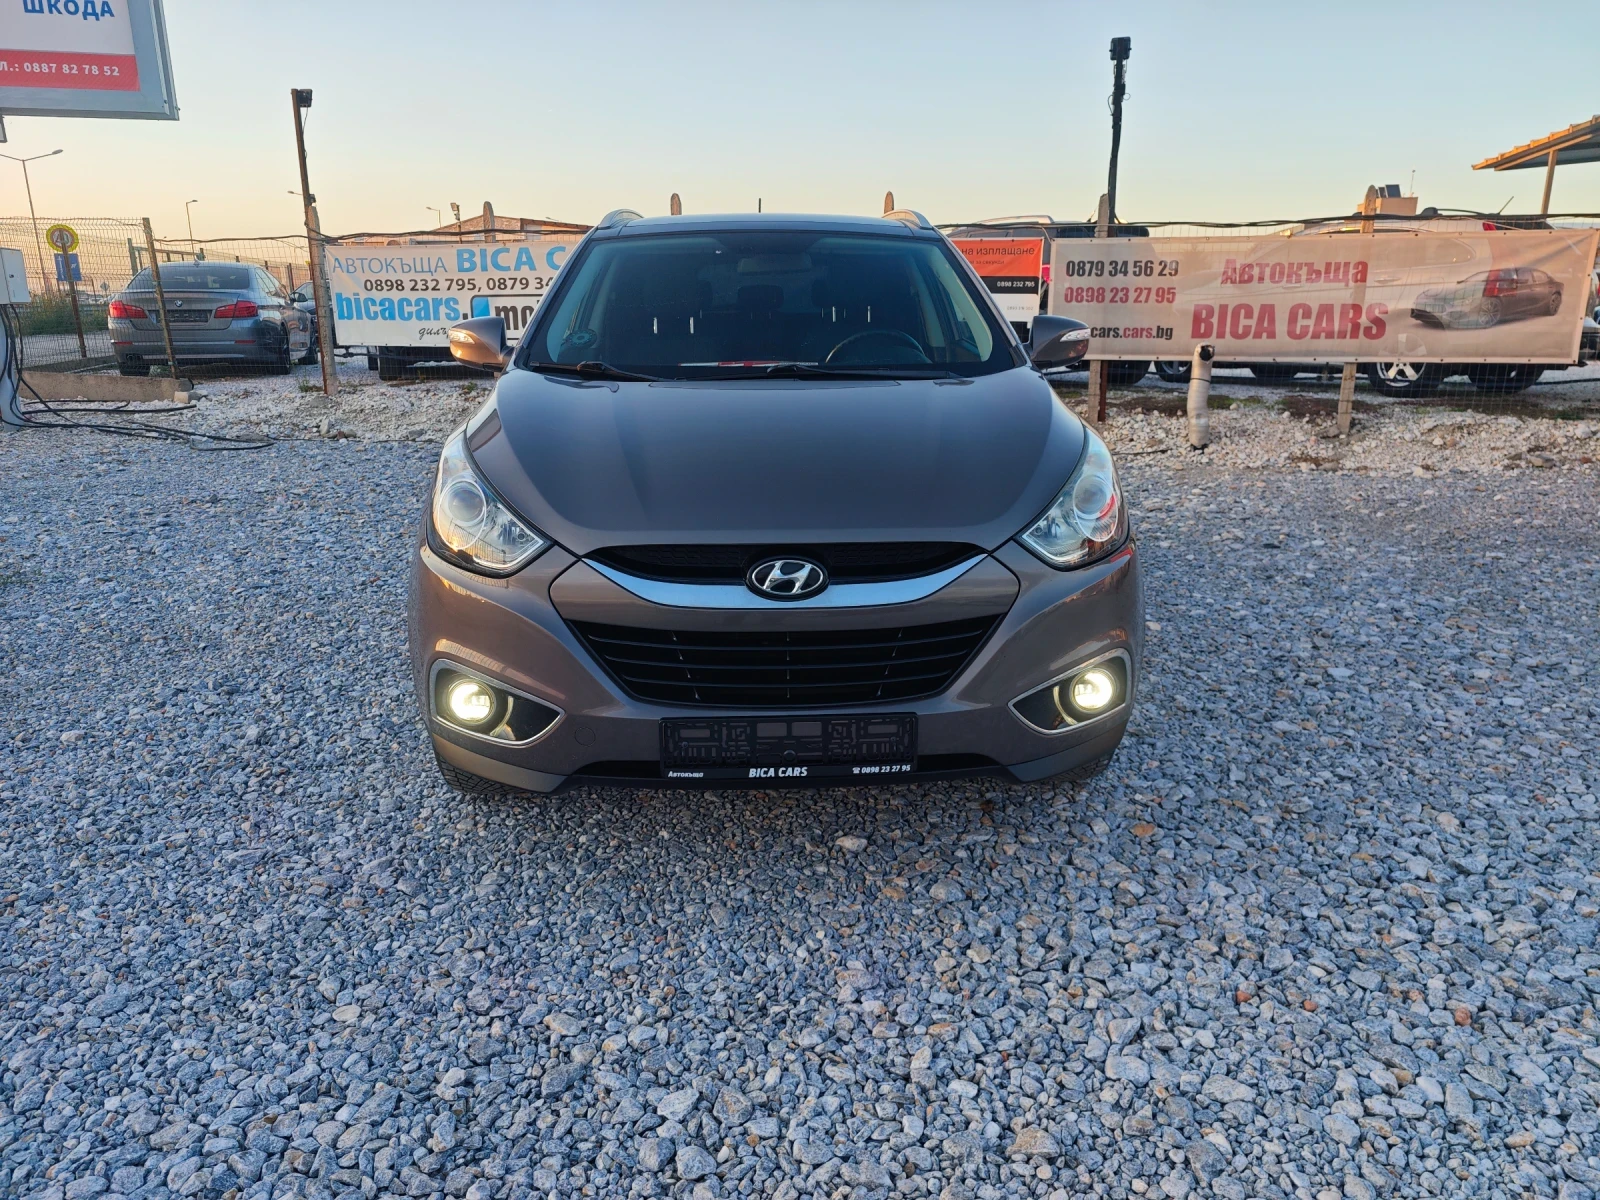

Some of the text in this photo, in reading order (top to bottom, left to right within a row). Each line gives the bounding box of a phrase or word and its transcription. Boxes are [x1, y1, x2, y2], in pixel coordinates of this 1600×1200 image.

[22, 0, 115, 21] ШКОДА
[24, 62, 57, 74] 0887
[62, 64, 79, 75] 82
[82, 65, 100, 75] 78
[103, 66, 120, 76] 52
[976, 247, 1035, 256] изплащане
[332, 256, 448, 277] АВТОКЪЩА
[456, 247, 537, 273] BICA
[1065, 260, 1180, 277] 0879 34 56 29
[1220, 258, 1368, 287] Автокъща
[364, 278, 405, 292] 0898
[409, 278, 441, 291] 232
[444, 277, 482, 293] 795,
[486, 277, 530, 291] 0879
[1064, 287, 1177, 304] 0898 23 27 95
[1191, 303, 1389, 340] BICA CARS
[749, 767, 808, 778] BICA CARS
[861, 766, 880, 774] 0898
[880, 765, 890, 773] 23
[901, 764, 911, 772] 95
